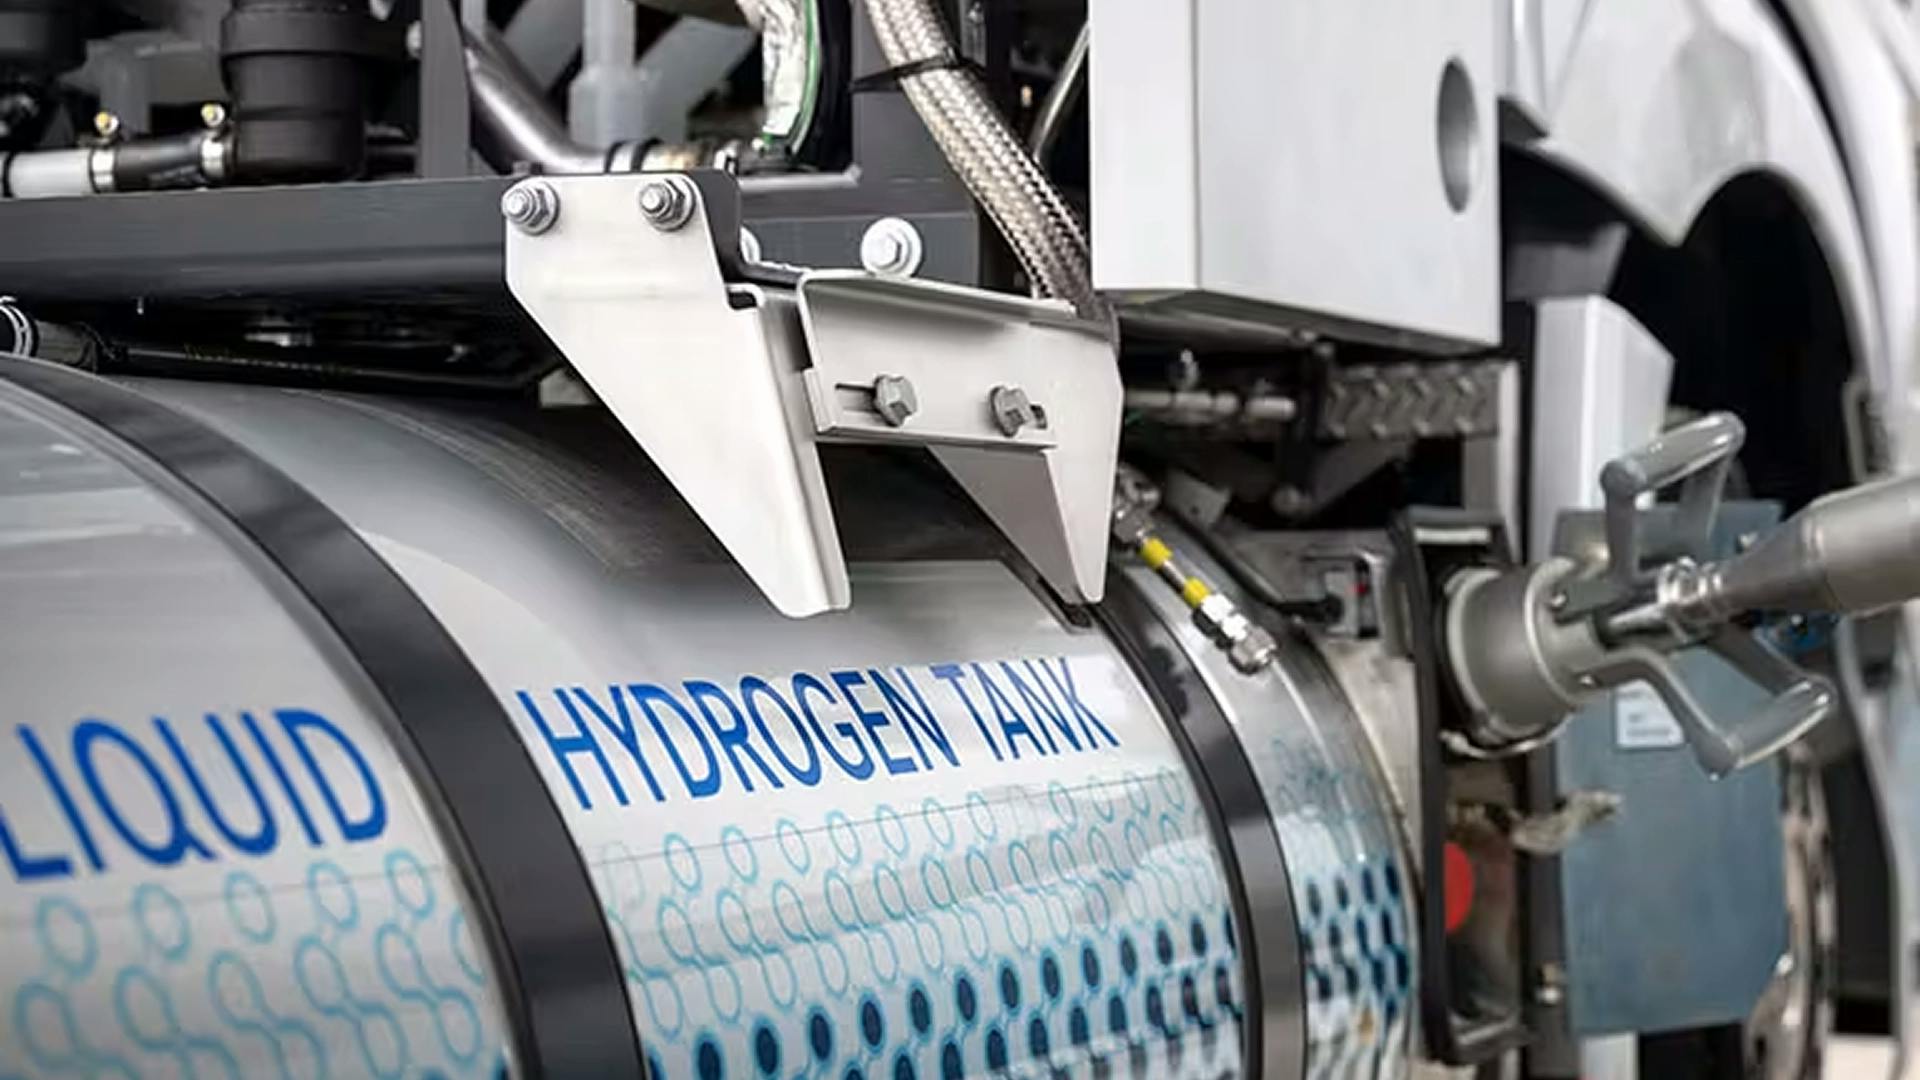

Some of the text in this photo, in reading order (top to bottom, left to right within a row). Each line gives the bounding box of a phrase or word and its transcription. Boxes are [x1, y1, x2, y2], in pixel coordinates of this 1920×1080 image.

[0, 657, 1120, 881] LIQUID HYDROGEN TANK
